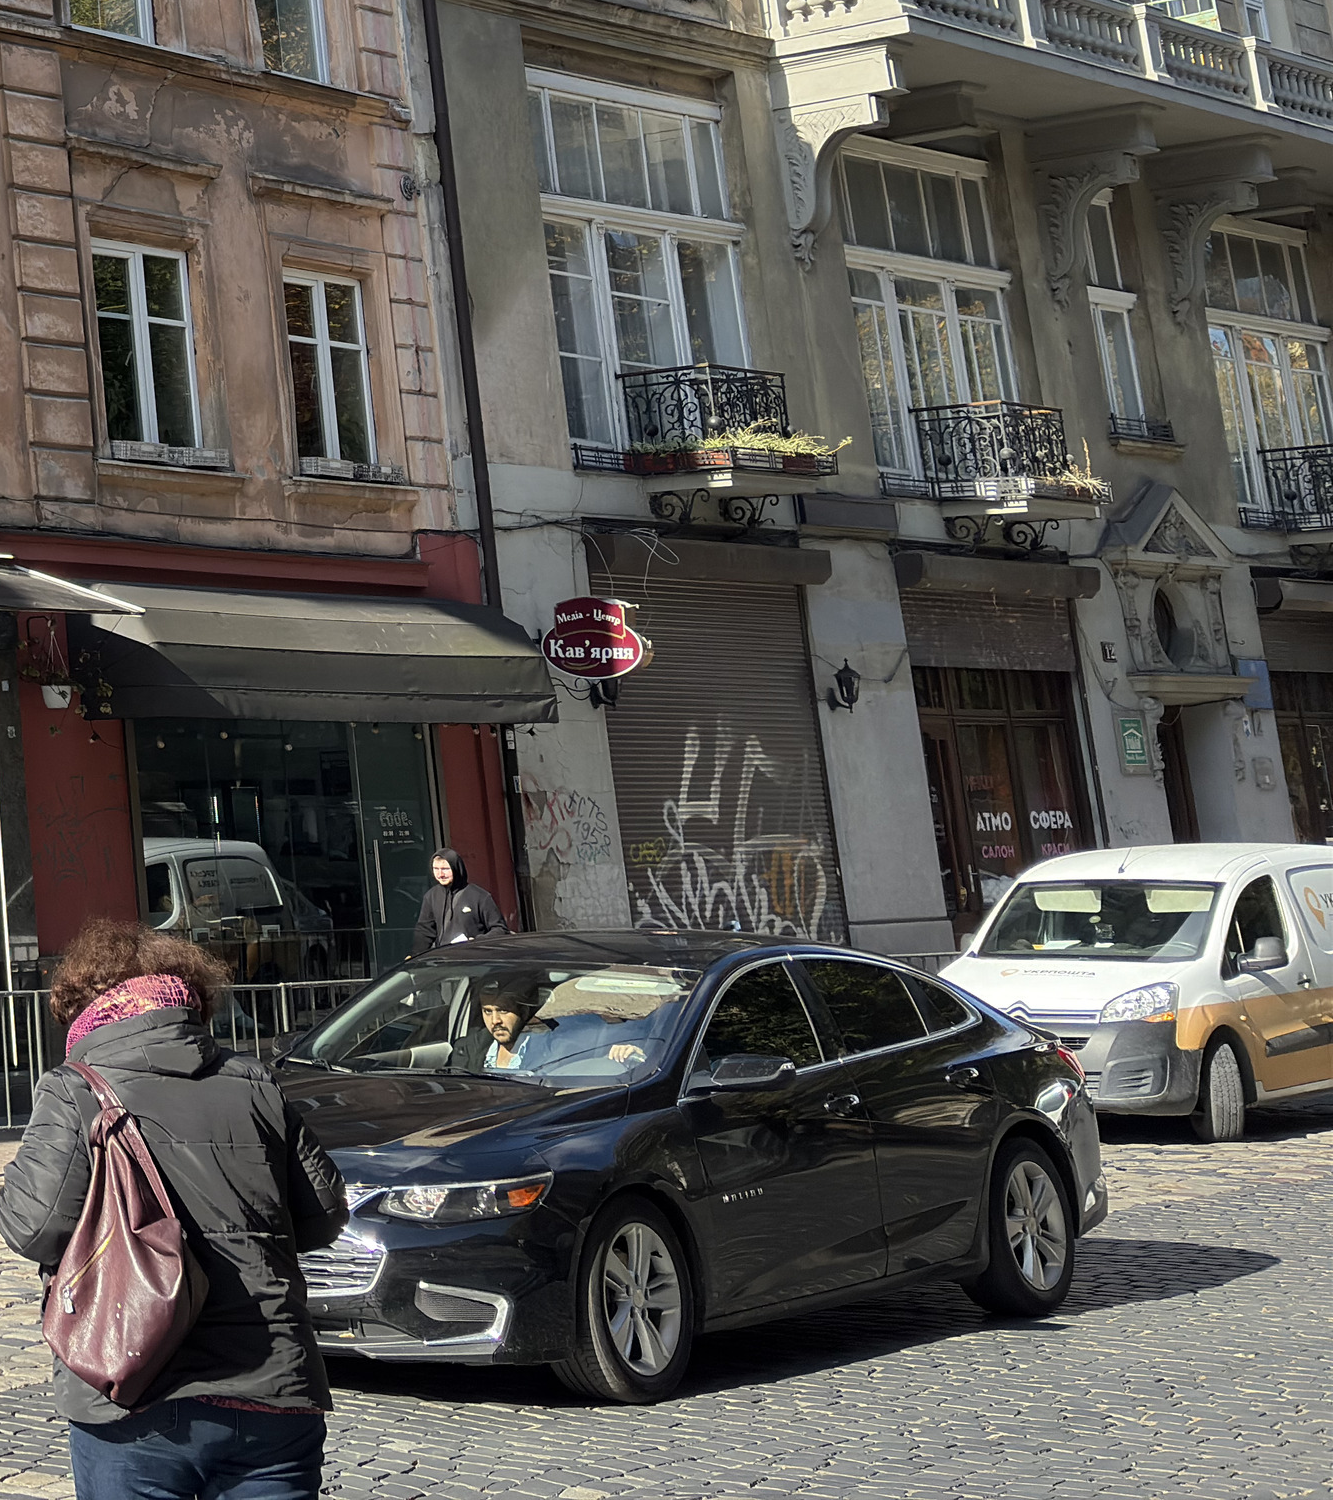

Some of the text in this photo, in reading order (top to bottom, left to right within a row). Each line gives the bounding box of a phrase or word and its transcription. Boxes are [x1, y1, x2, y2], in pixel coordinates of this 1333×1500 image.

[556, 610, 584, 624] Медіа
[593, 609, 621, 626] Центр
[549, 639, 634, 664] Кав'ярня
[976, 810, 1074, 831] АТМО СФЕРА
[982, 845, 1015, 859] САЛОН
